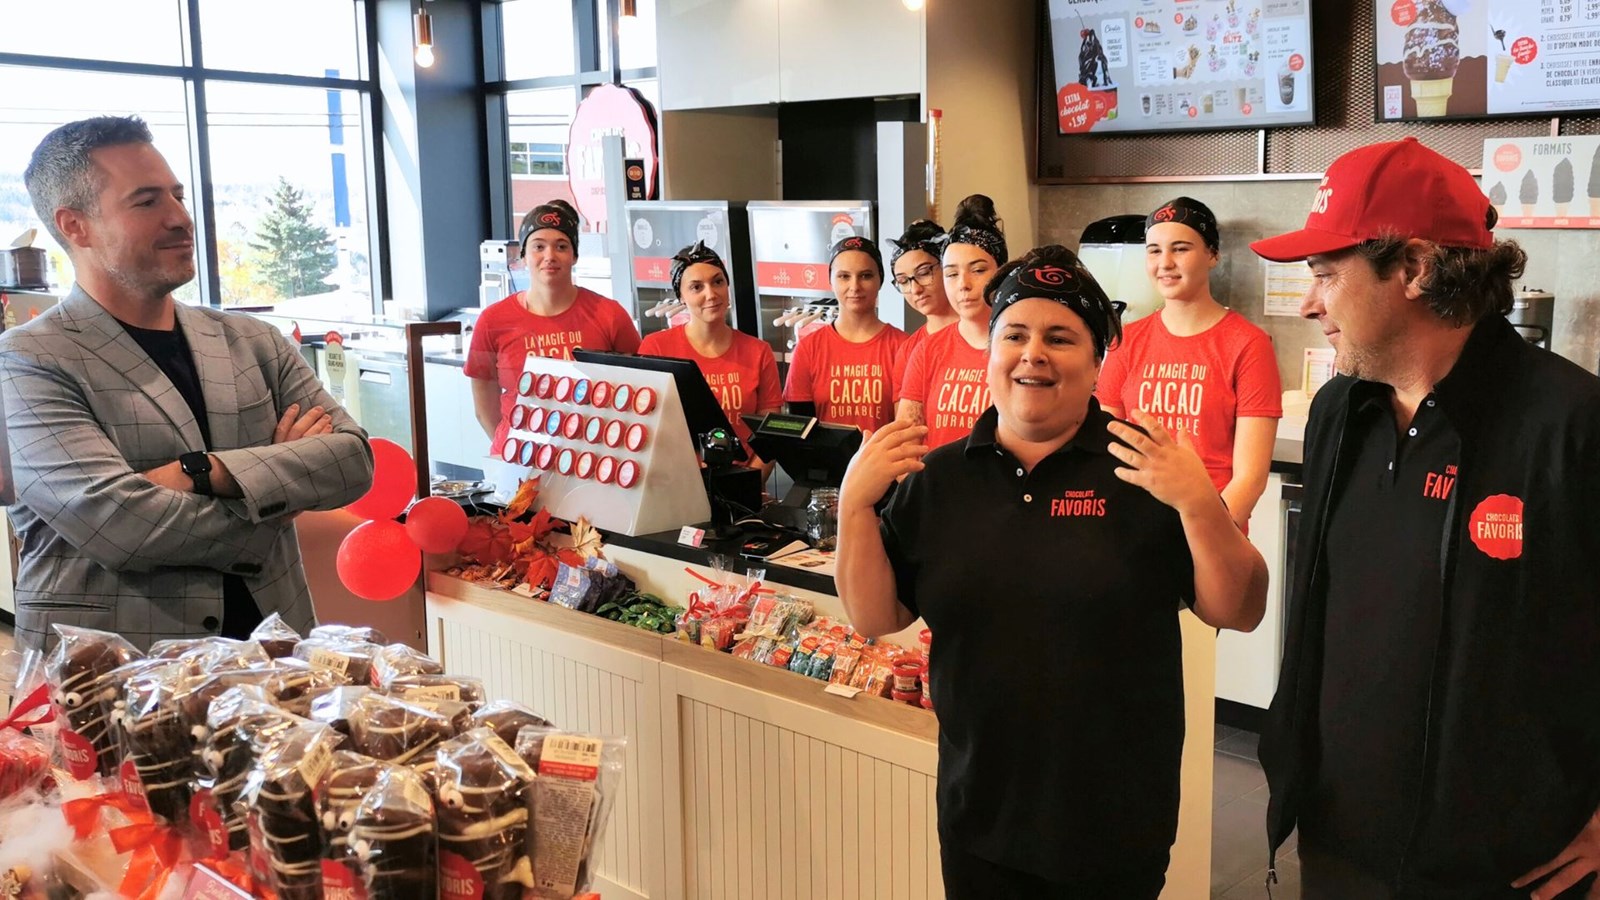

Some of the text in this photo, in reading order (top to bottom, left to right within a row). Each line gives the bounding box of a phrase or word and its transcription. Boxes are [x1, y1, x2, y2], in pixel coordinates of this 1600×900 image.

[1554, 69, 1579, 78] CHOCOLAT
[1546, 79, 1573, 87] CLASSIQUE
[1064, 92, 1081, 105] EXTRA
[1060, 98, 1091, 117] chocolat
[1533, 142, 1572, 155] FORMATS
[524, 330, 582, 350] LA MAGIE DU
[705, 371, 740, 385] AGIE DU
[831, 363, 882, 378] LA MAGIE DU
[944, 367, 986, 383] LA MAGIE
[1142, 362, 1207, 381] LA MAGIE DU
[830, 378, 883, 404] CACAO
[937, 382, 992, 414] CACAO
[1138, 380, 1204, 417] CACAO
[830, 404, 882, 420] DURABLE
[935, 413, 976, 430] DURAB
[1157, 415, 1200, 437] RABLE
[1065, 489, 1095, 498] CHOCOLATS
[1050, 497, 1106, 517] FAVORIS
[1485, 512, 1520, 523] CHOCOLATS
[1476, 520, 1523, 541] FAVORIS
